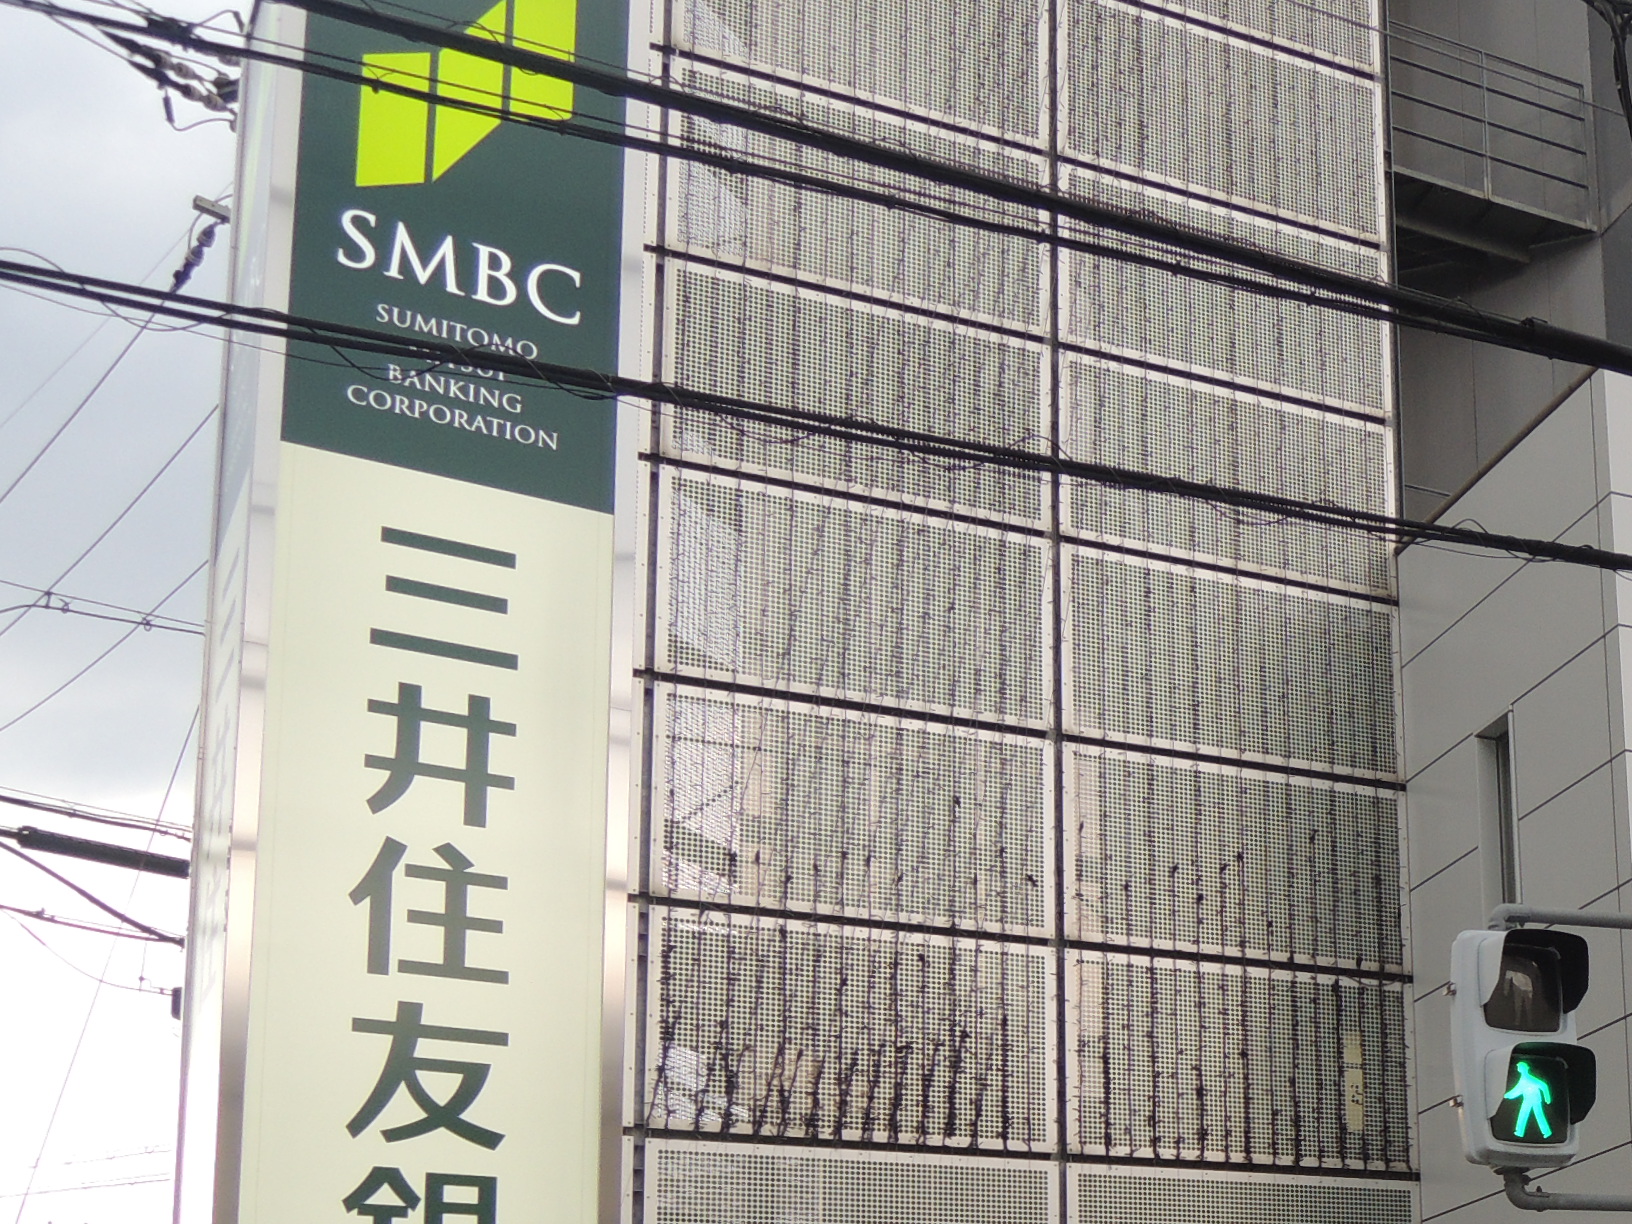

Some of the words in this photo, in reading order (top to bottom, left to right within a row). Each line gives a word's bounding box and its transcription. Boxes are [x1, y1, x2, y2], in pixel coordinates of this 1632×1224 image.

[336, 209, 582, 326] SMBC
[376, 303, 538, 361] SUMITOMO
[346, 384, 558, 451] CORPORATION
[387, 363, 523, 413] BANKING
